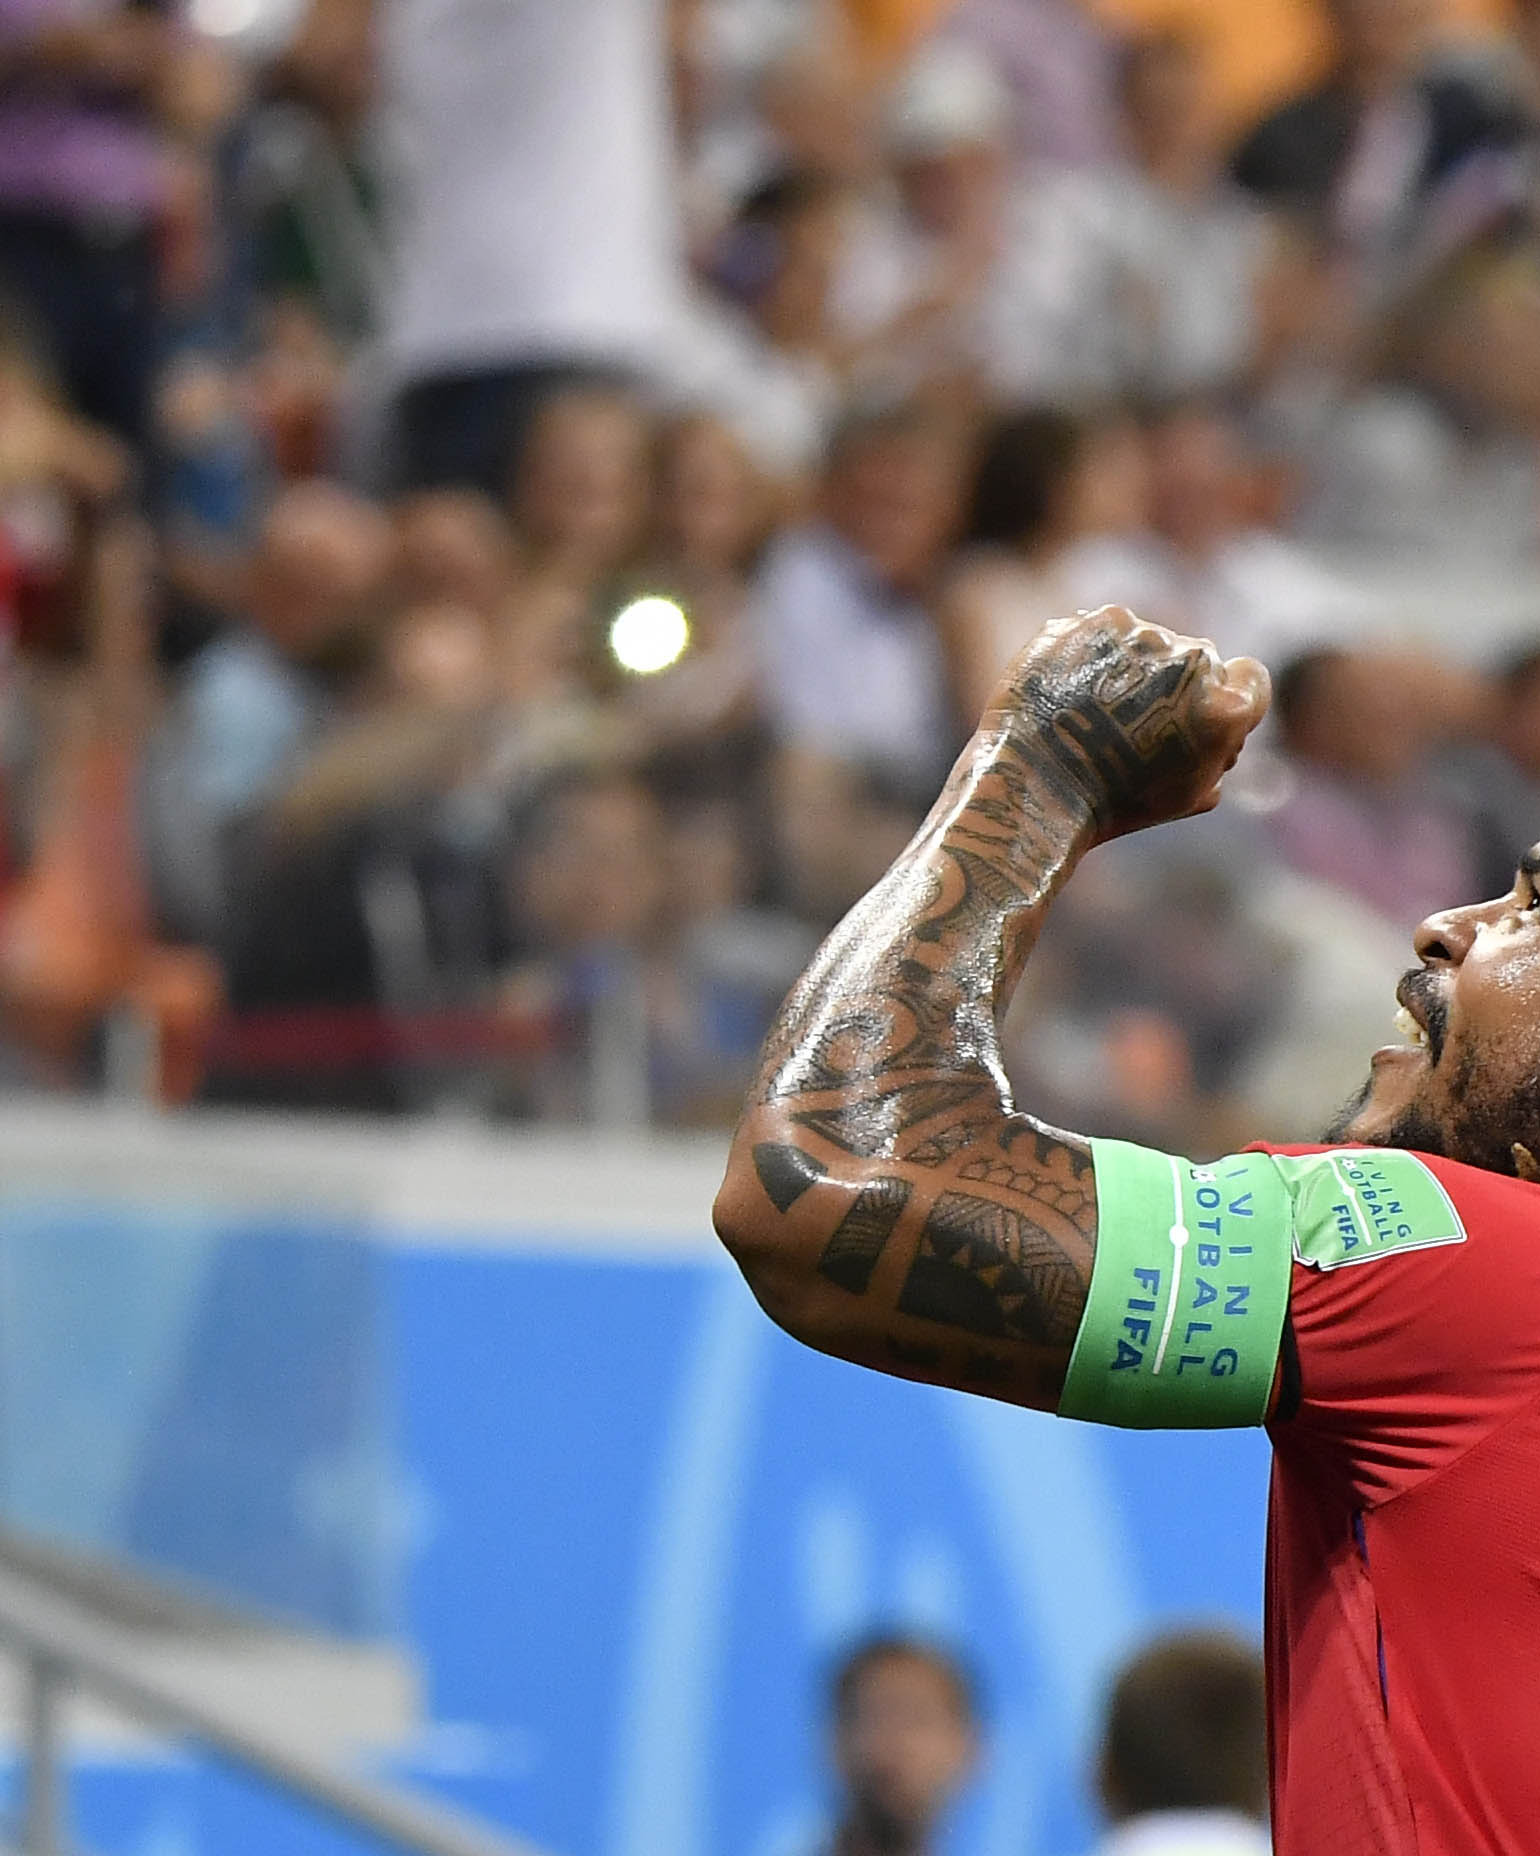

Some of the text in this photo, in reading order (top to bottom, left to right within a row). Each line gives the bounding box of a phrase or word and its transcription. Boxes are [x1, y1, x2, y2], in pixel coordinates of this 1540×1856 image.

[1331, 1203, 1360, 1252] FIFA
[1360, 1160, 1412, 1240] IVING
[1210, 1167, 1254, 1378] IVING
[1110, 1267, 1161, 1371] FIFA
